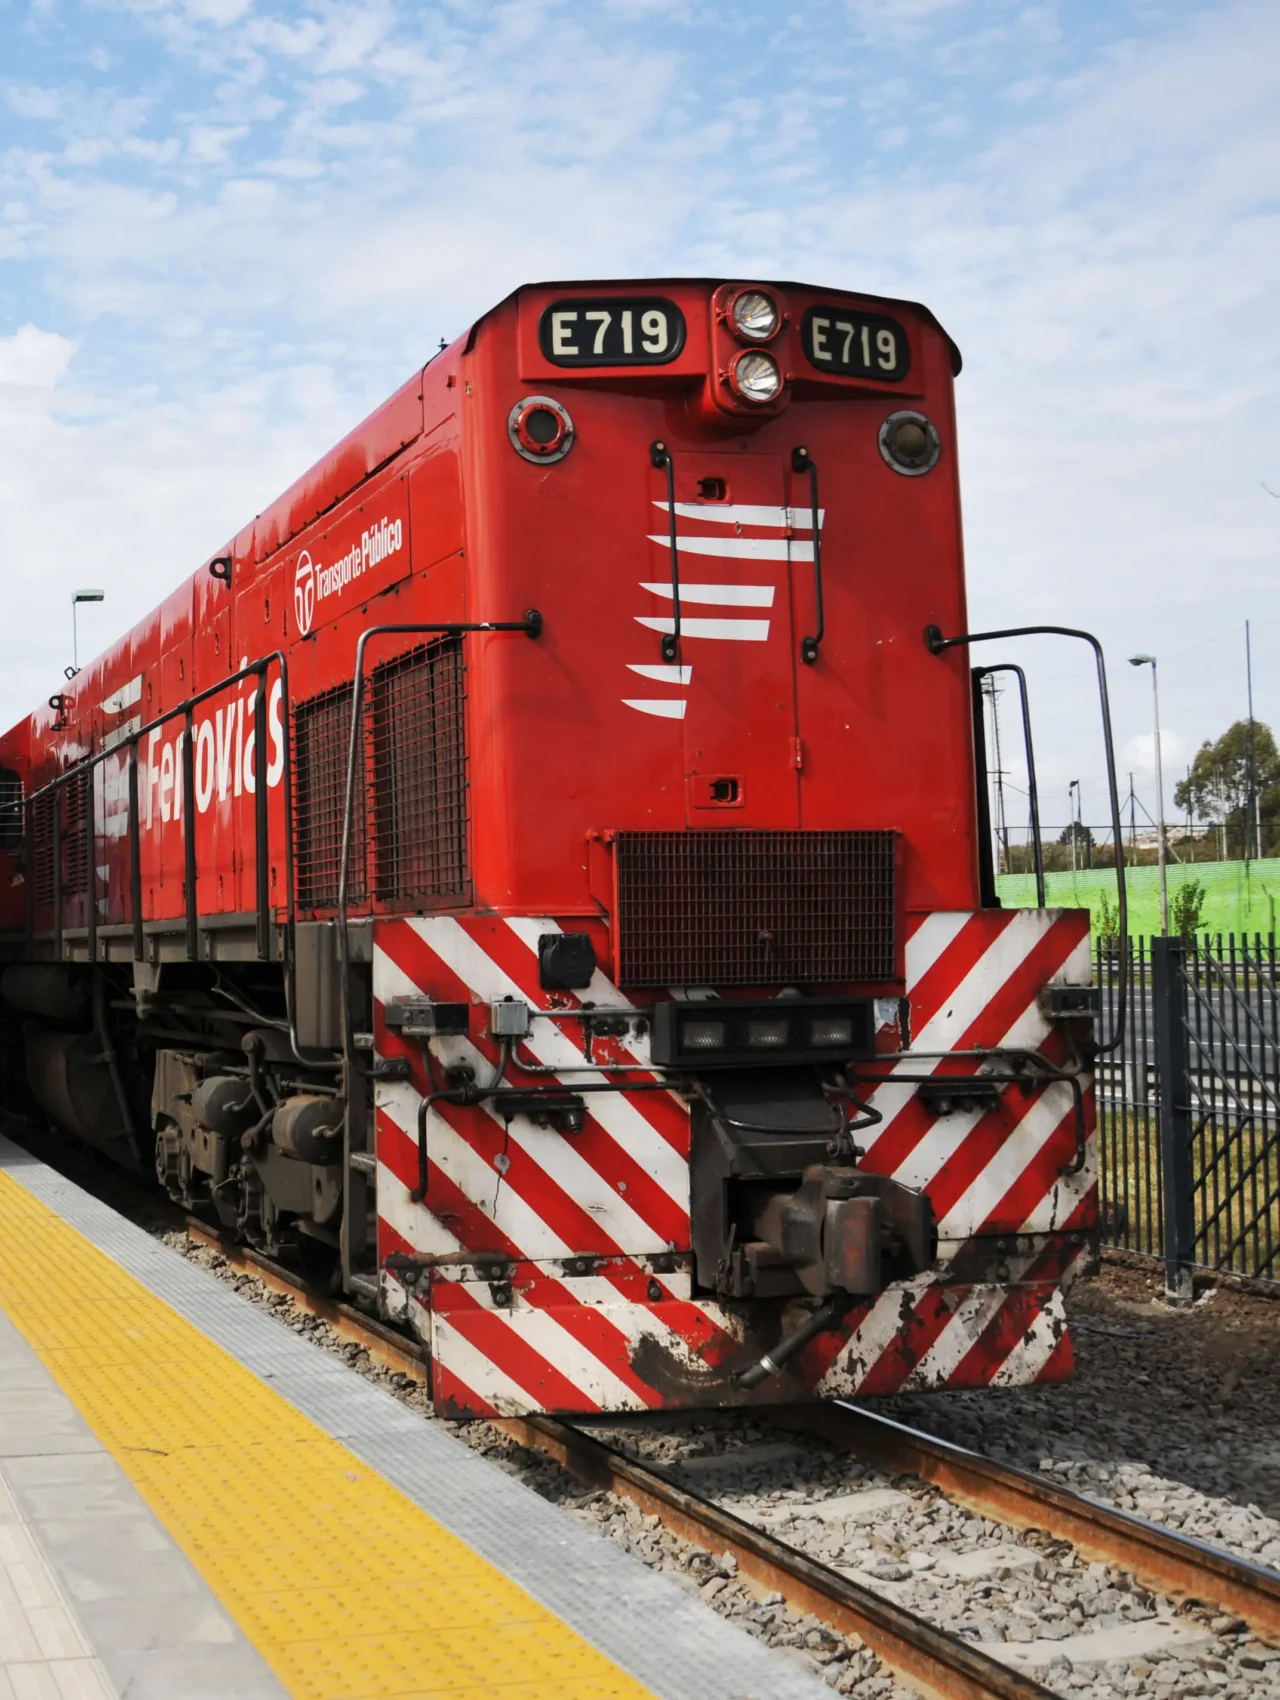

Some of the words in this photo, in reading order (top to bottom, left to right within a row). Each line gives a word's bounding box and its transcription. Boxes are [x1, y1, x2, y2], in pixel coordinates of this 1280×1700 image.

[551, 309, 669, 356] E719
[811, 316, 897, 371] E719
[315, 544, 362, 601] Transporte
[361, 516, 402, 573] Público
